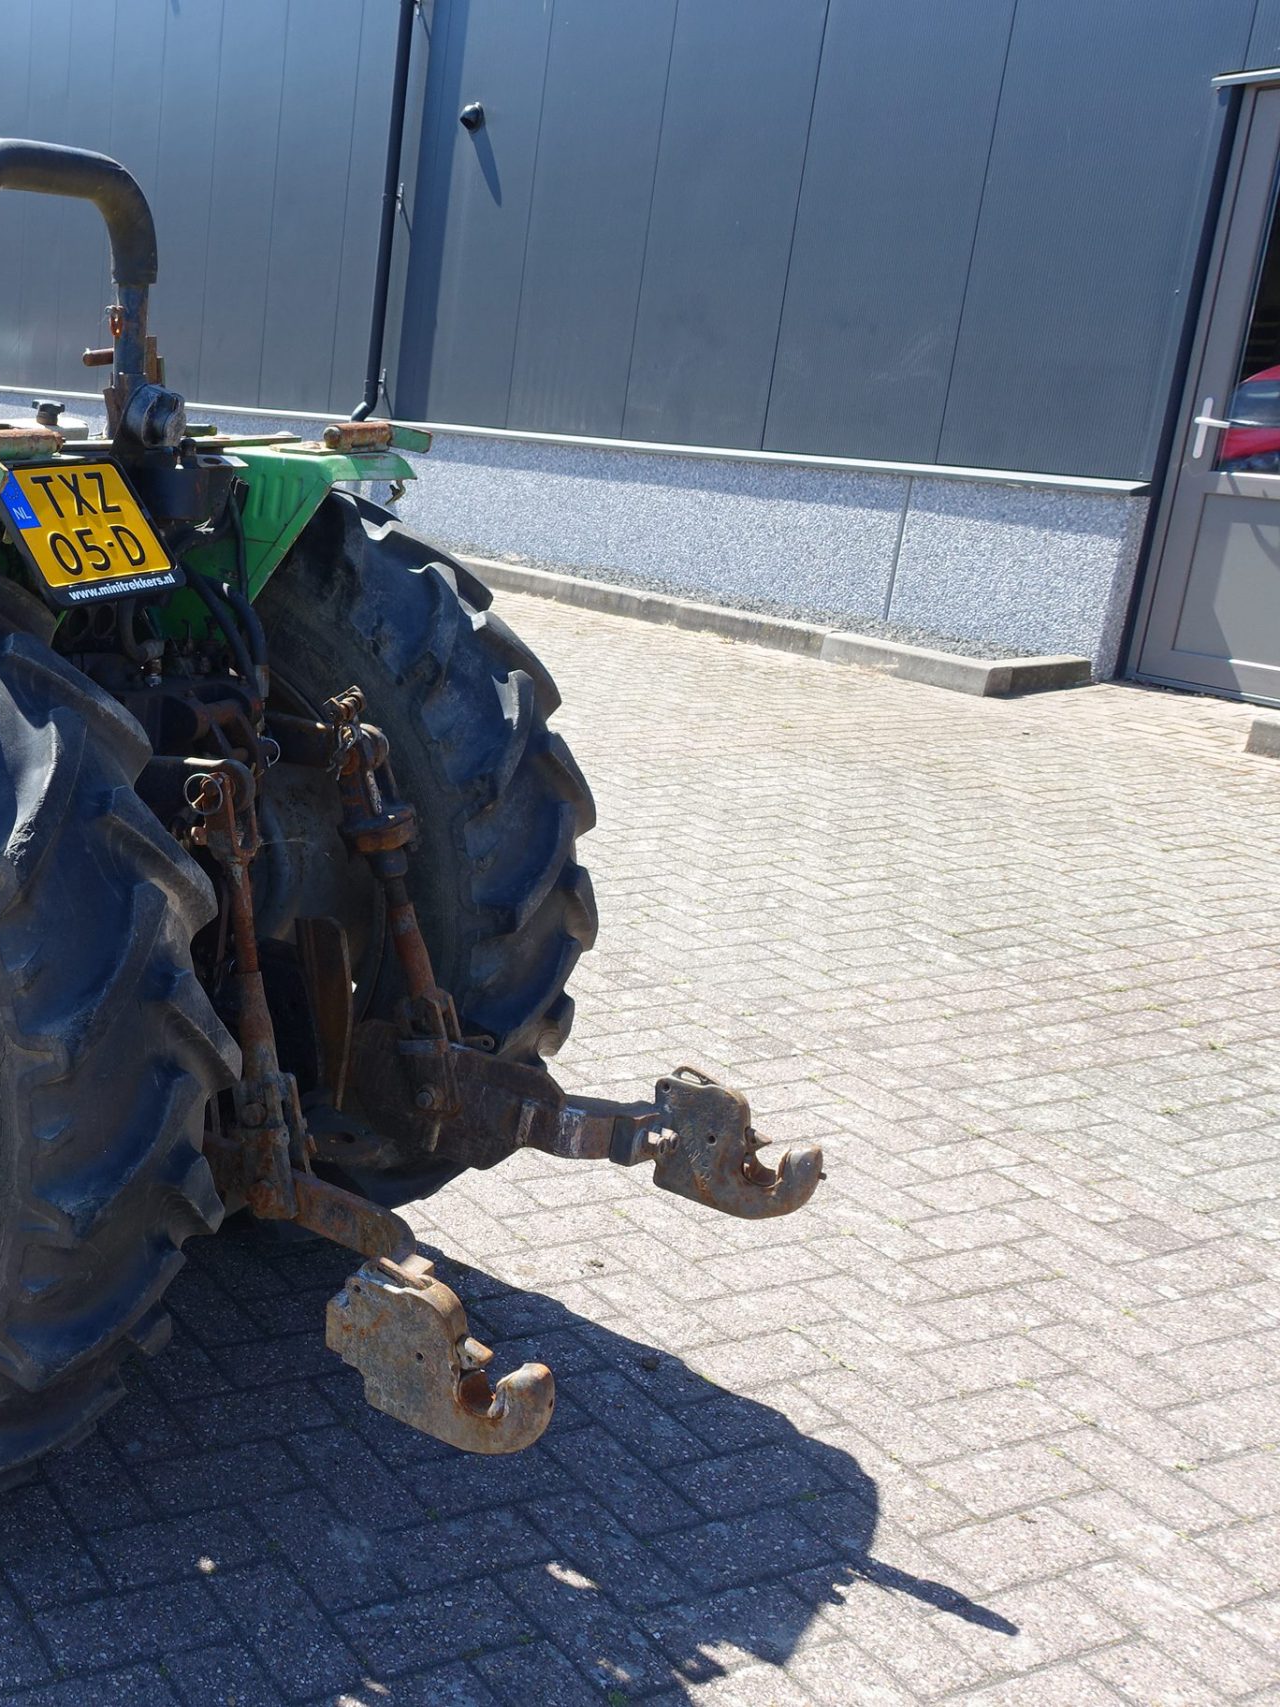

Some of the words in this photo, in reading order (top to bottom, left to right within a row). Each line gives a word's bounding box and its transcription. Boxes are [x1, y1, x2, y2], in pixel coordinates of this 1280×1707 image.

[30, 472, 122, 519] TXZ
[12, 506, 32, 520] NL
[68, 573, 176, 601] www.minitrekkers.nl
